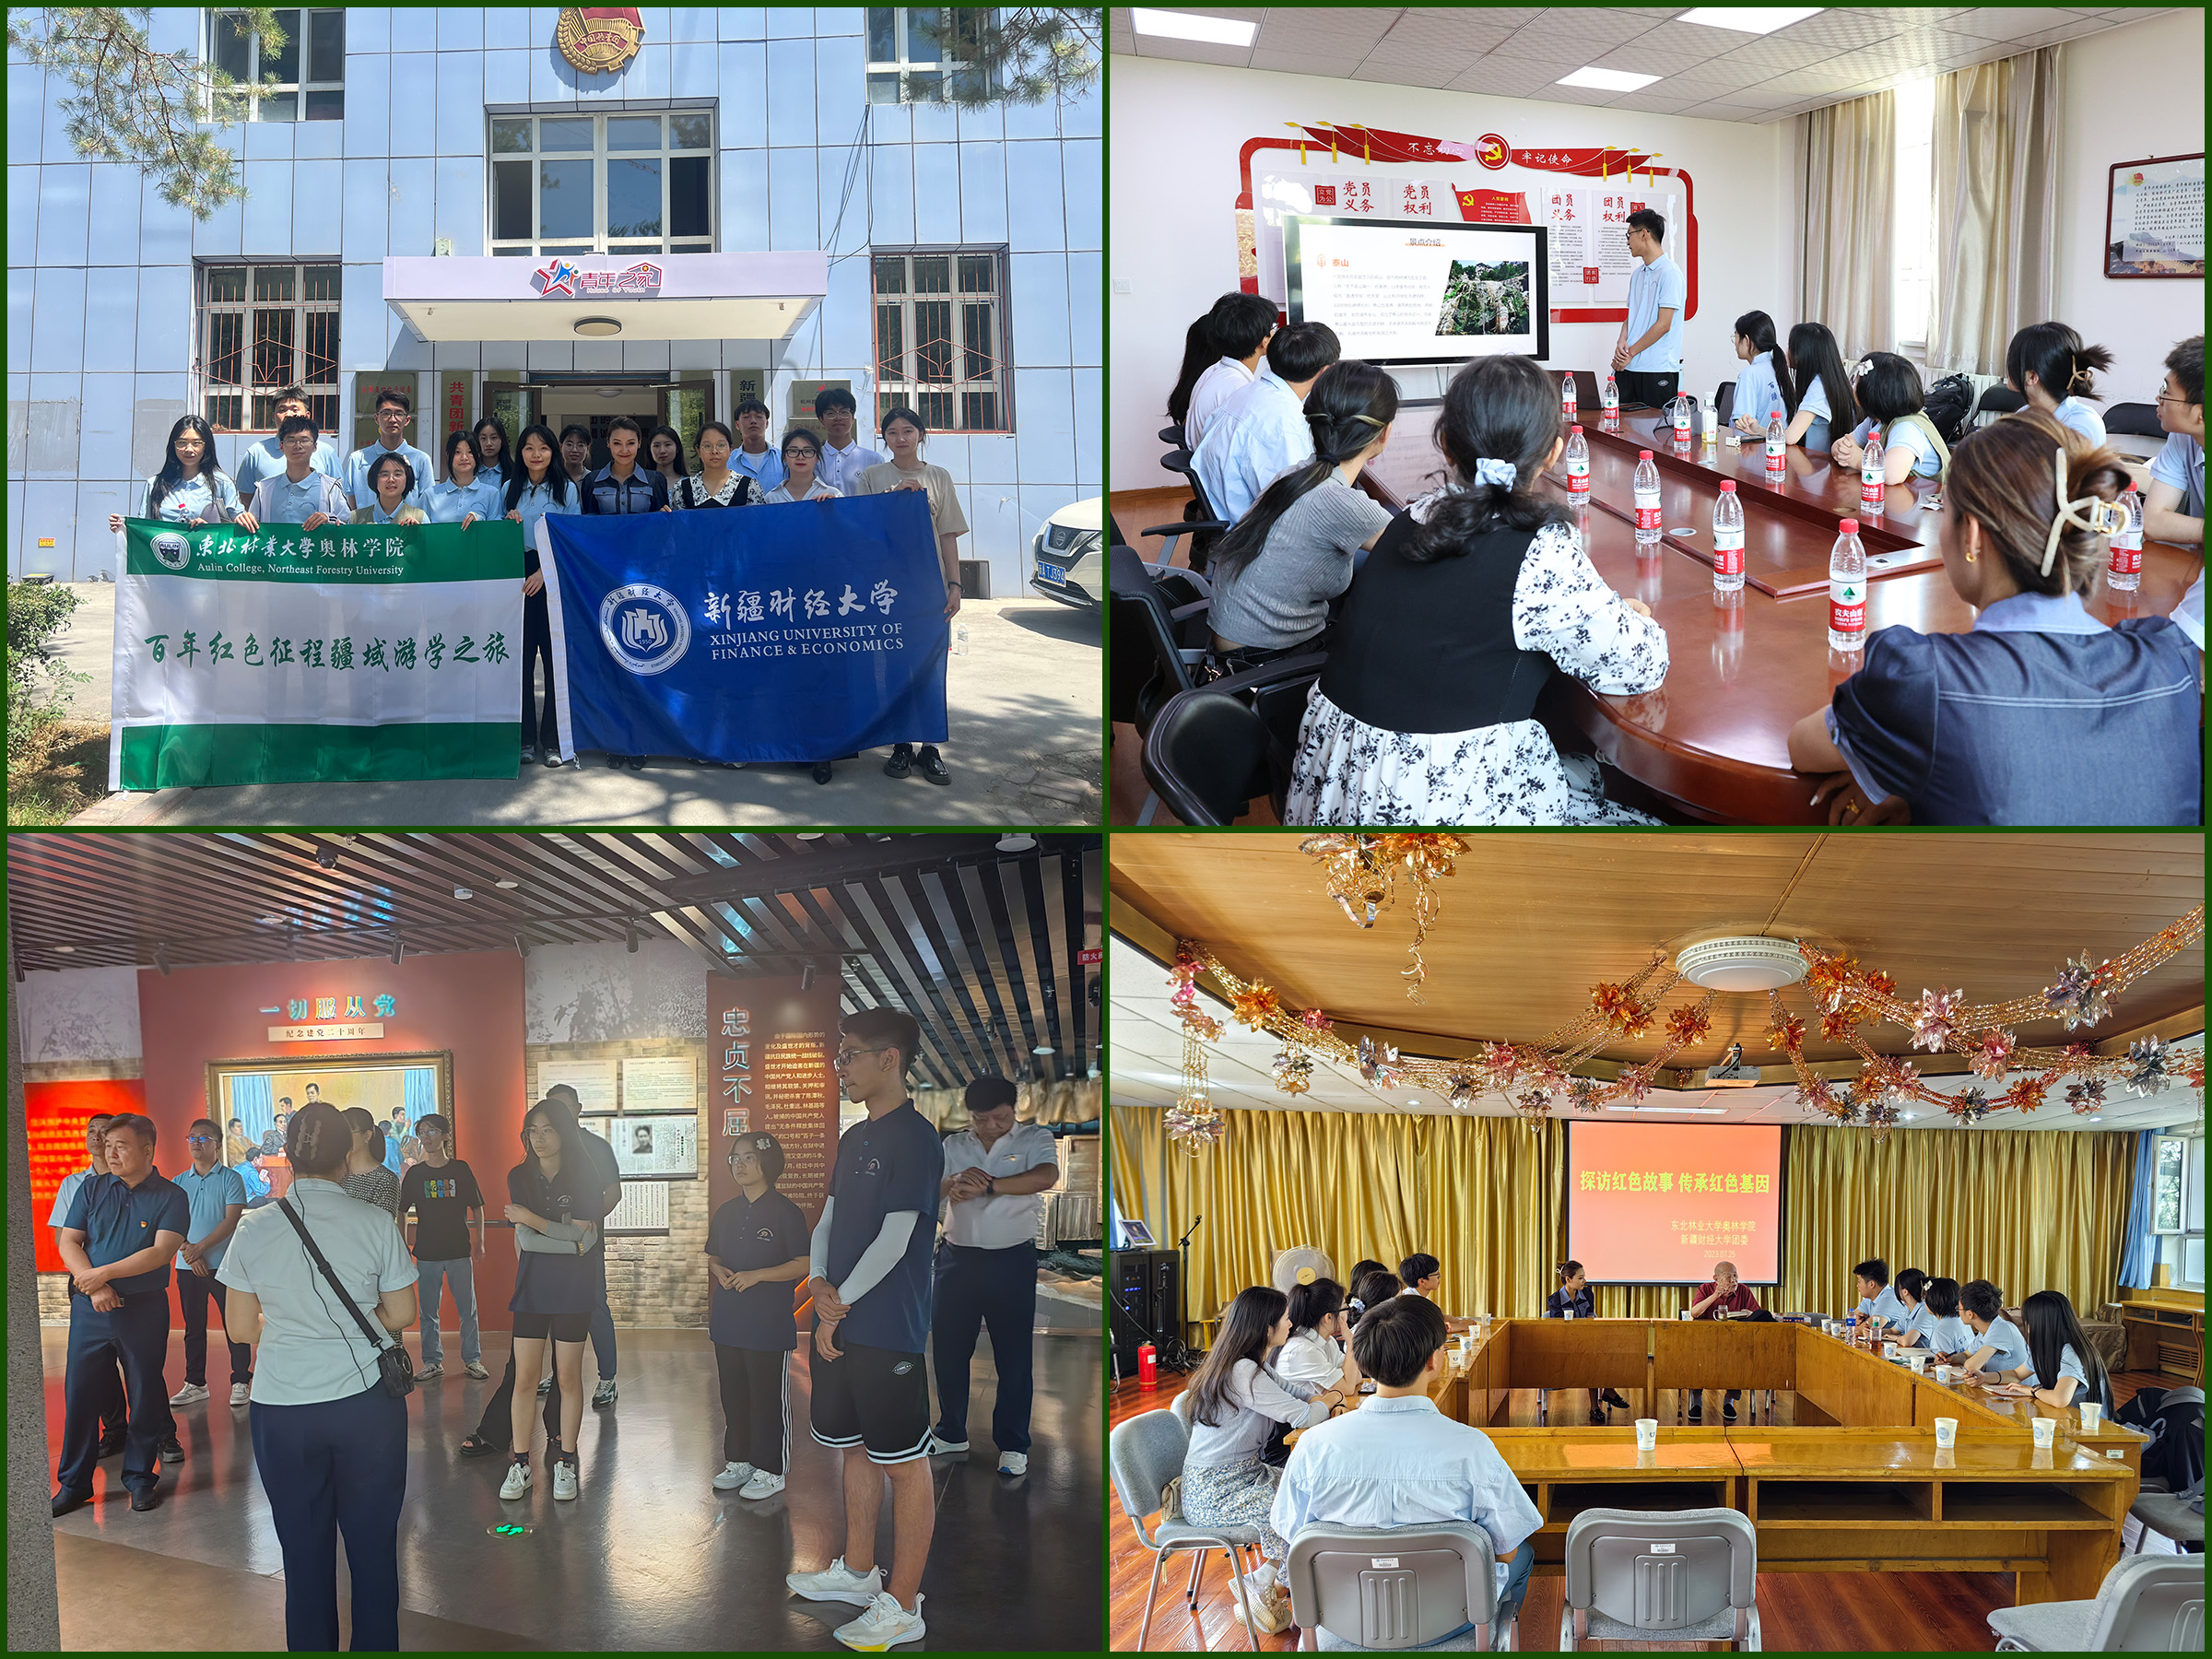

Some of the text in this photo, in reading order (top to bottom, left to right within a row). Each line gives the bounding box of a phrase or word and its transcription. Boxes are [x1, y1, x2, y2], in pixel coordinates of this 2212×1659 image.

[1407, 142, 1465, 156] 不忘初心
[1522, 150, 1572, 167] 牢记使命
[1343, 181, 1371, 197] 党员
[1403, 184, 1430, 200] 党员
[1343, 199, 1374, 213] 义务
[1551, 194, 1574, 207] 团员
[1603, 196, 1625, 209] 团员
[1403, 201, 1432, 216] 权利
[1551, 208, 1576, 221] 义务
[1602, 210, 1625, 223] 权利
[1409, 238, 1441, 246] 景点介绍
[1332, 258, 1349, 267] 泰山
[580, 269, 661, 288] 青年之家
[197, 562, 404, 576] Aulin College, Northeast Forestry University
[703, 579, 899, 630] 新疆财经大学
[1834, 608, 1863, 618] 农夫山泉
[710, 622, 902, 647] XINJIANG UNIVERSITY OF
[144, 629, 511, 673] 百年红色征程疆域游学之旅
[712, 638, 904, 661] FINANCE & ECONOMICS
[258, 994, 395, 1020] 一切服从党
[286, 1027, 366, 1038] 纪念建党二十周年
[722, 1006, 752, 1136] 忠贞不屈
[1580, 1170, 1770, 1194] 探访红色故事 传承红色基因
[1670, 1219, 1756, 1232] 东北林业大学奥林学院
[1680, 1233, 1748, 1246] 新疆财经大学团委
[1703, 1250, 1735, 1259] 2023.07.25
